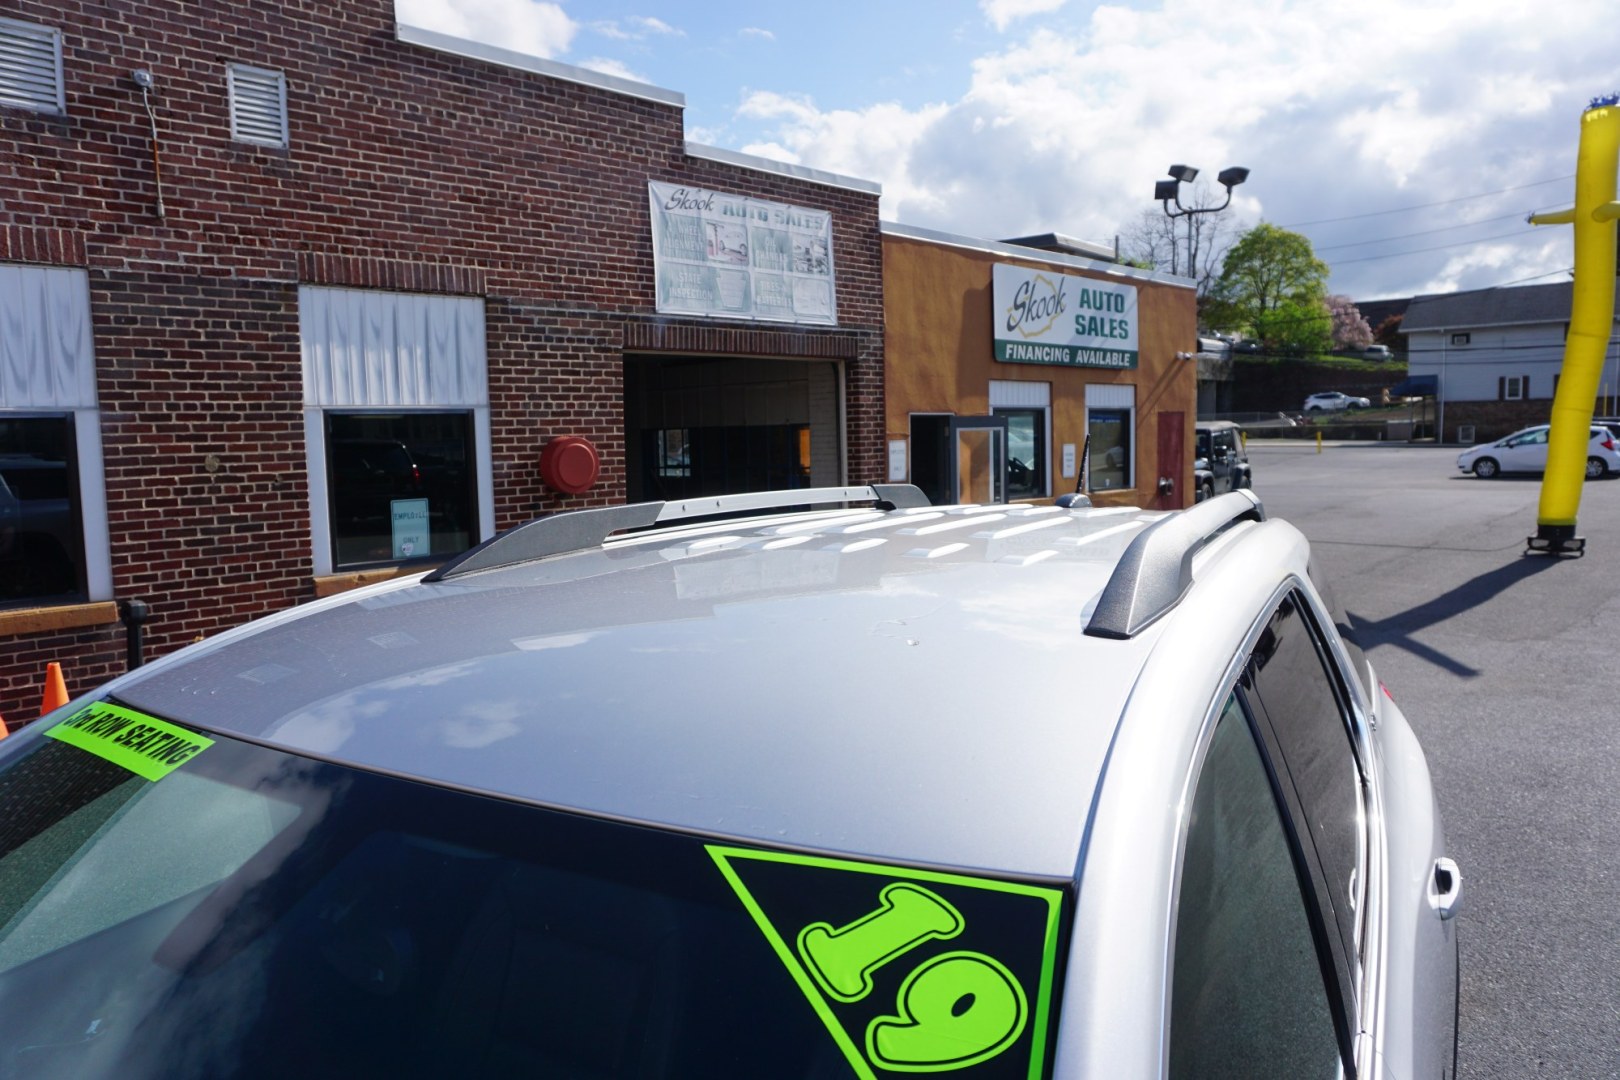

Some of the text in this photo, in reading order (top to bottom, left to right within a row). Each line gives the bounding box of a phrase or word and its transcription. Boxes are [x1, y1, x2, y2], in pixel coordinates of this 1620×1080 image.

[664, 188, 824, 231] Skook AUTO SALES
[1006, 276, 1067, 332] Skook
[1079, 287, 1125, 313] AUTO
[1075, 314, 1129, 340] SALES
[1005, 343, 1131, 367] FINANCING AVAILABLE
[63, 708, 201, 766] 3rd ROW SEATING
[797, 882, 1028, 1073] 19
